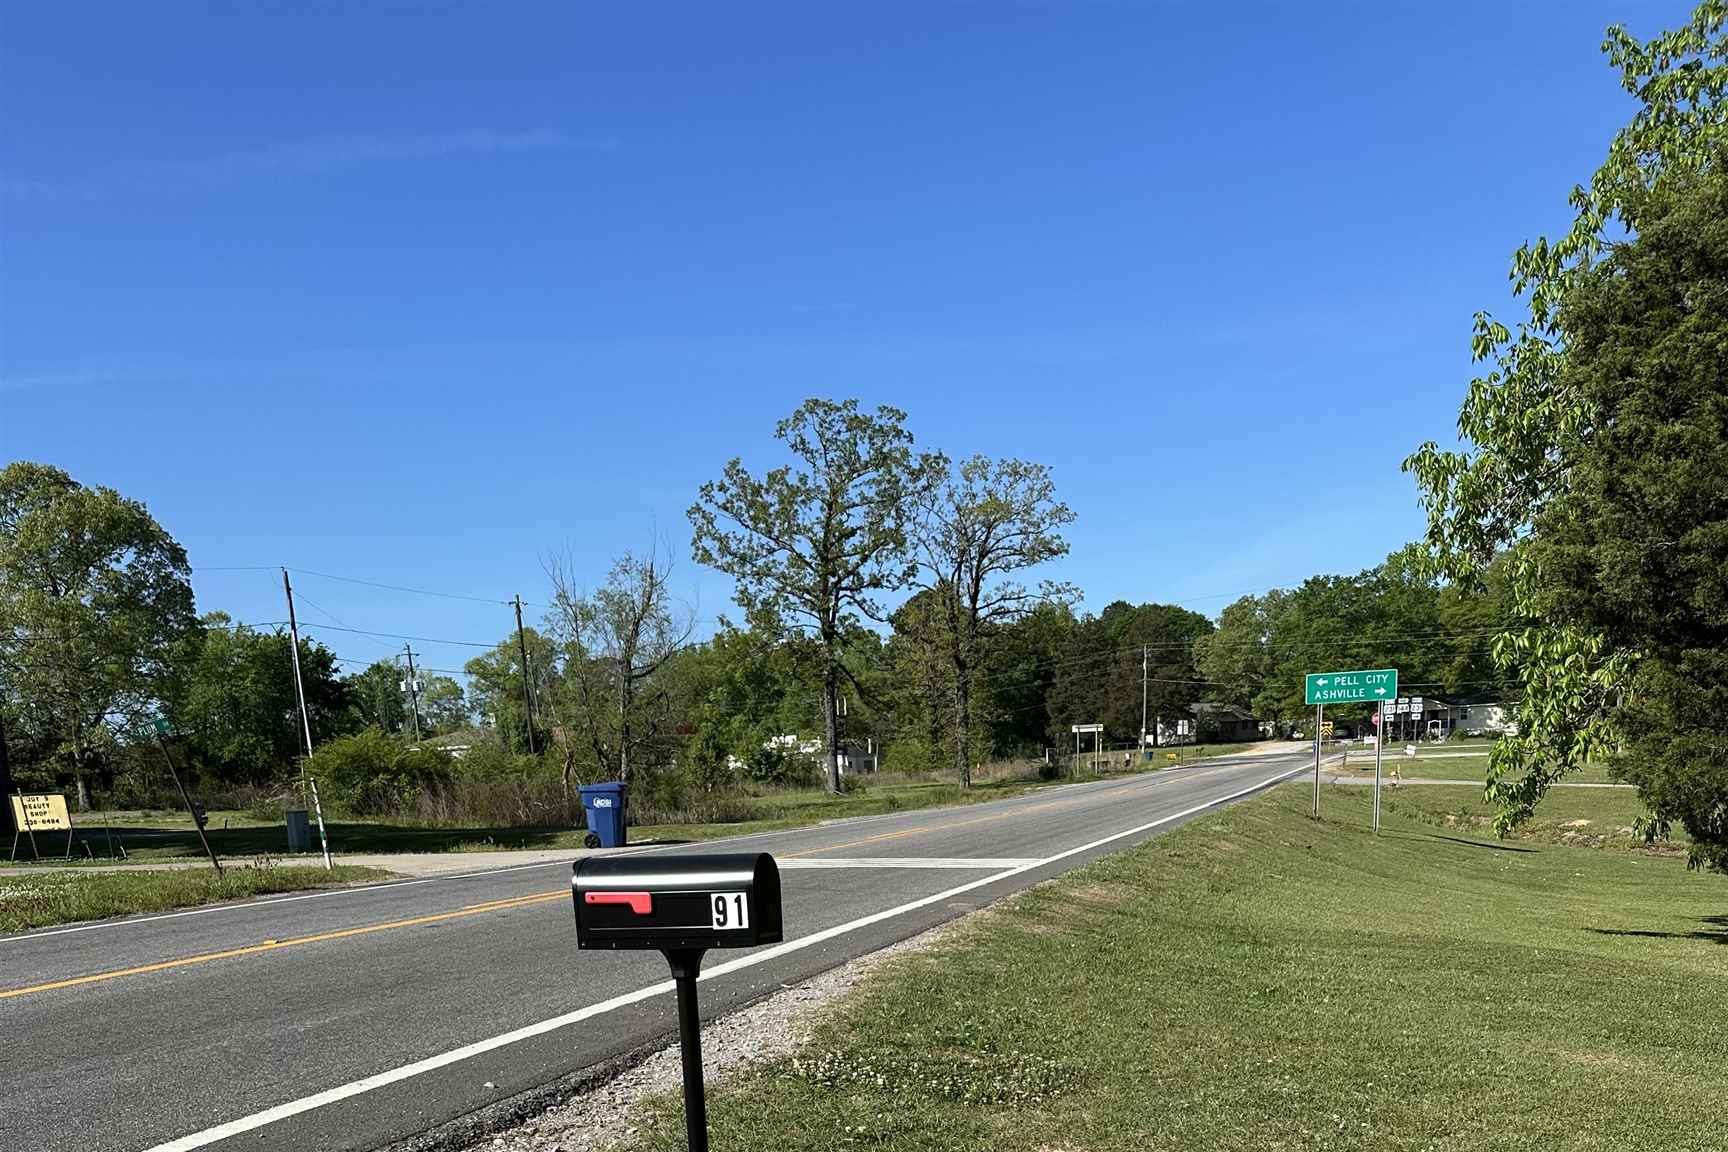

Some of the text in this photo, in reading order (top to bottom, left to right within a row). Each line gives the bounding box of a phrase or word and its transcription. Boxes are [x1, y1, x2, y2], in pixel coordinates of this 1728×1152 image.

[1334, 674, 1388, 686] PELL CITY
[1315, 688, 1365, 700] ASHVILLE
[714, 894, 743, 928] 91
